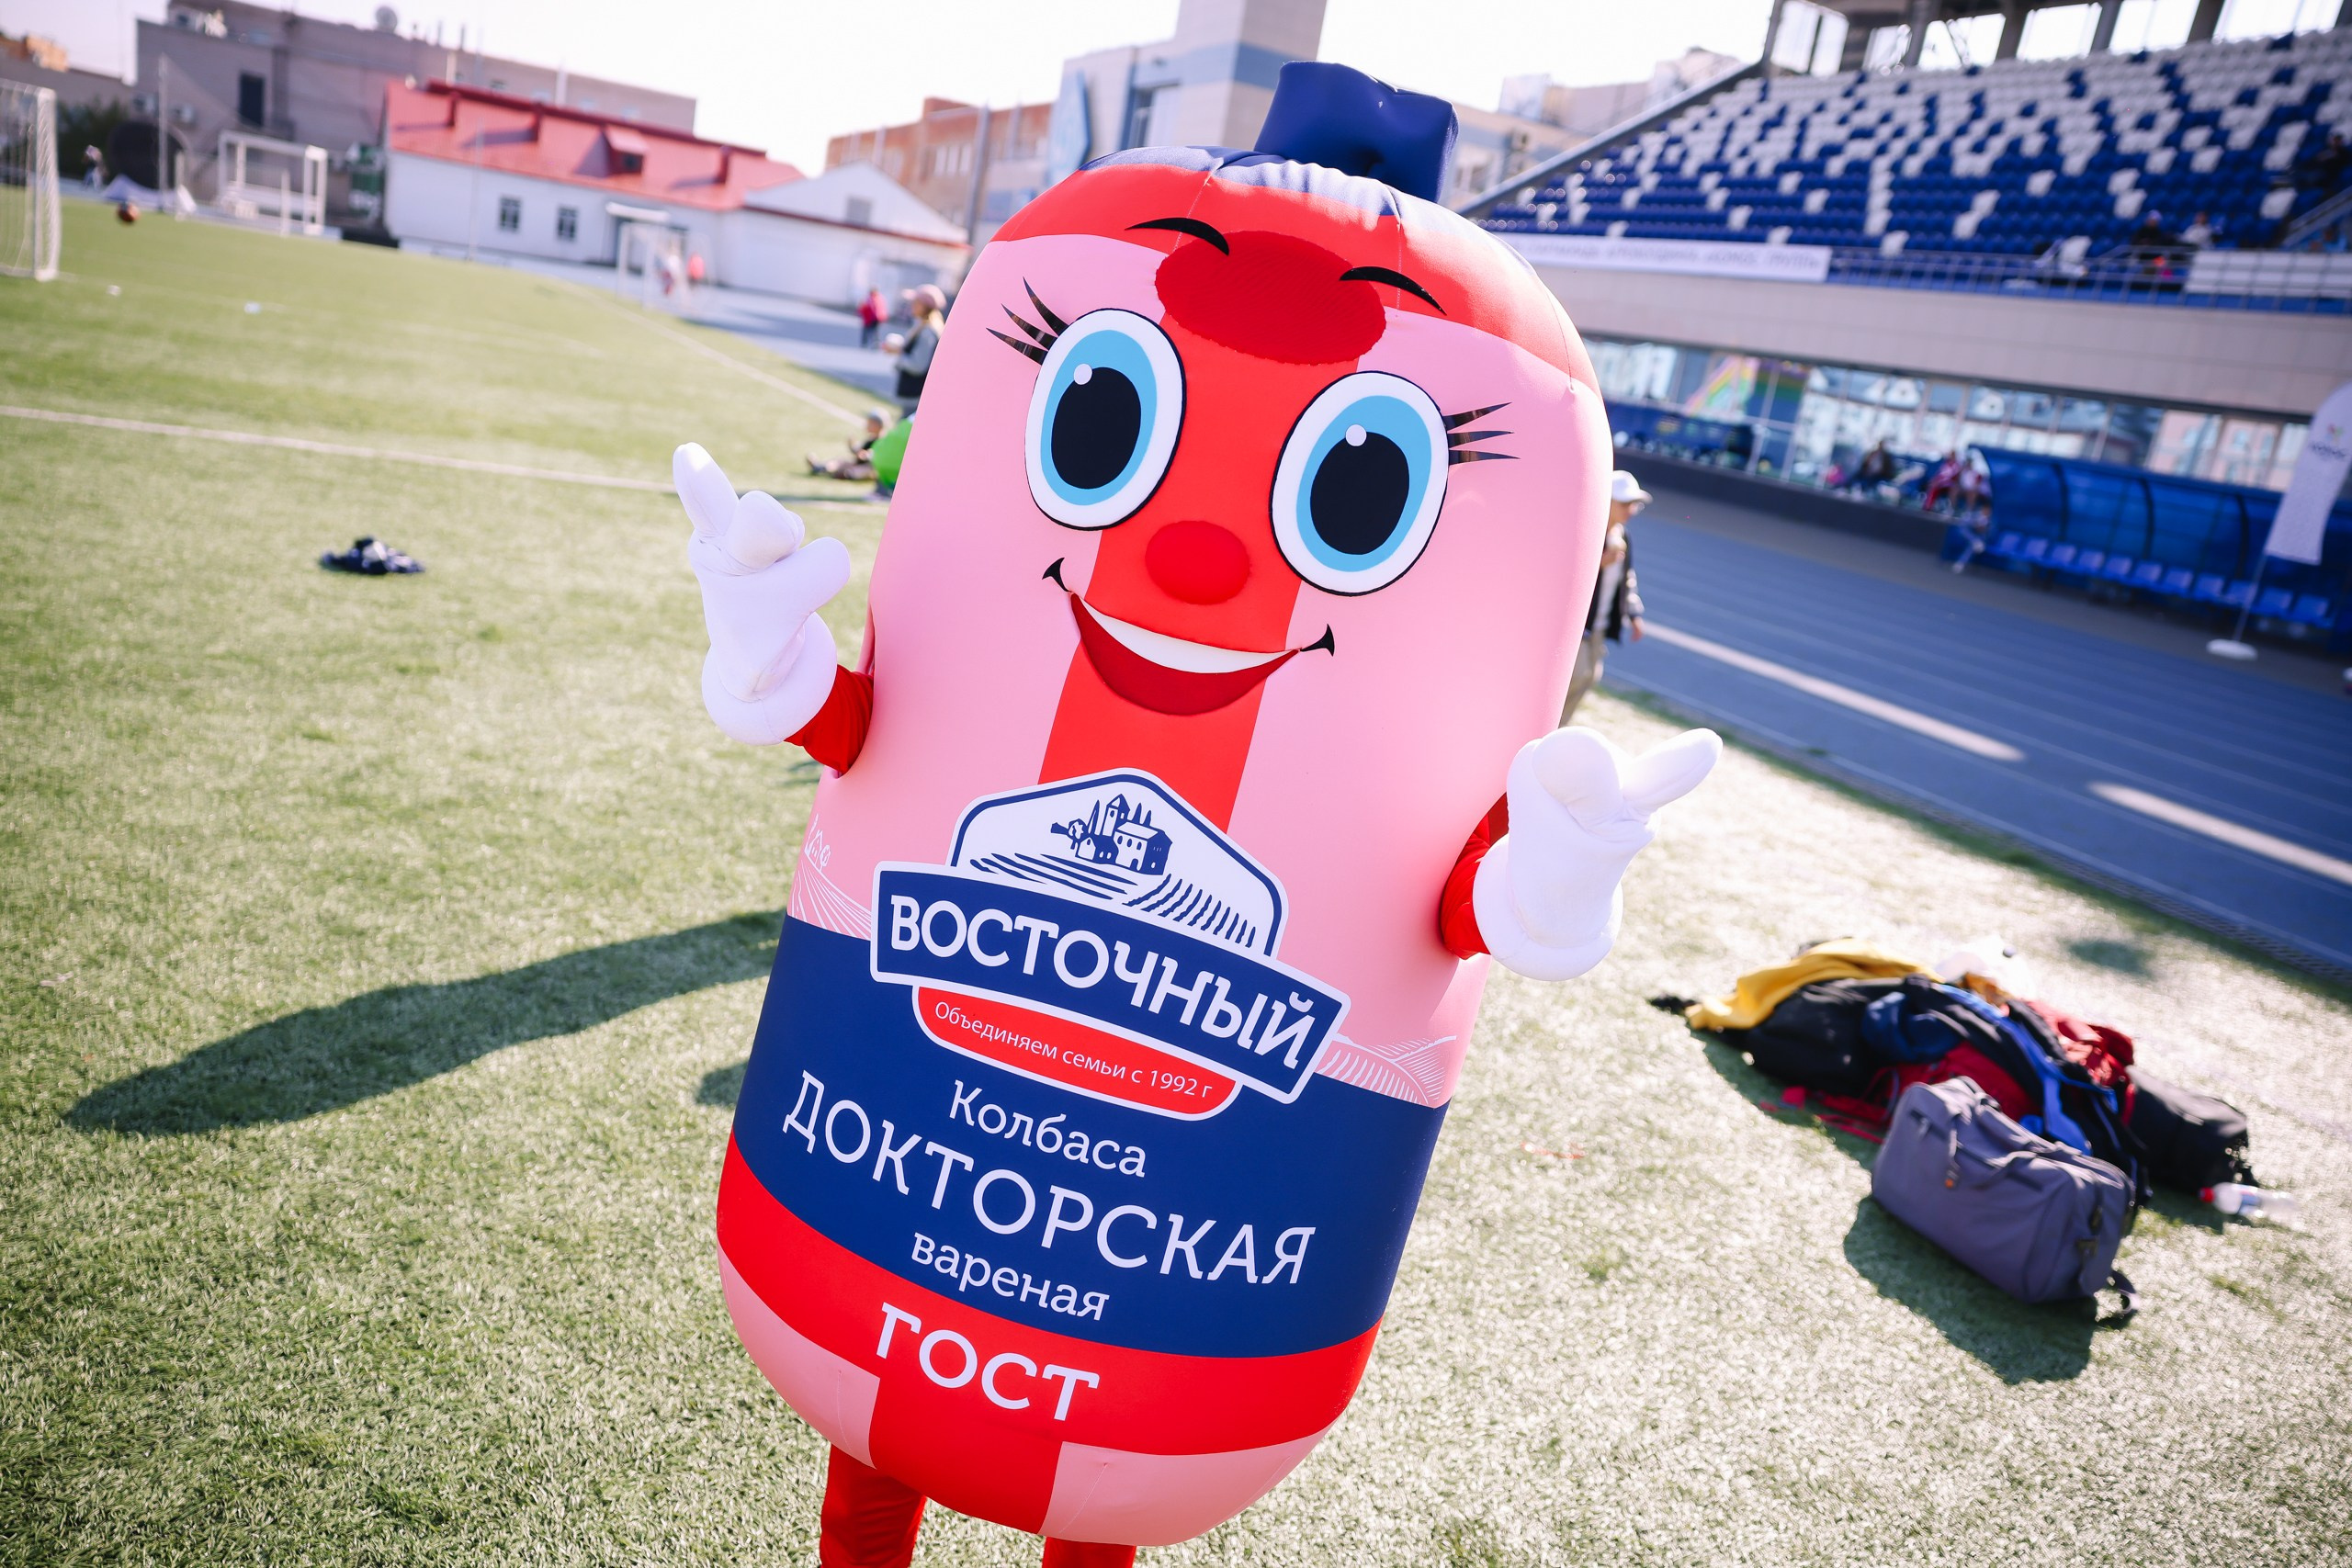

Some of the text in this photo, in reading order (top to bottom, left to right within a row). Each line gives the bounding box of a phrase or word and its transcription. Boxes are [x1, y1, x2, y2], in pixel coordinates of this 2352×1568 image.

[890, 894, 1316, 1070] ВОСТОЧНЫЙ
[935, 1001, 1213, 1099] Объединяем семьи с 1992 г
[782, 1069, 1317, 1285] ДОКТОРСКАЯ
[949, 1079, 1146, 1178] Колбаса
[911, 1232, 1110, 1321] вареная
[876, 1302, 1101, 1421] ГОСТ
